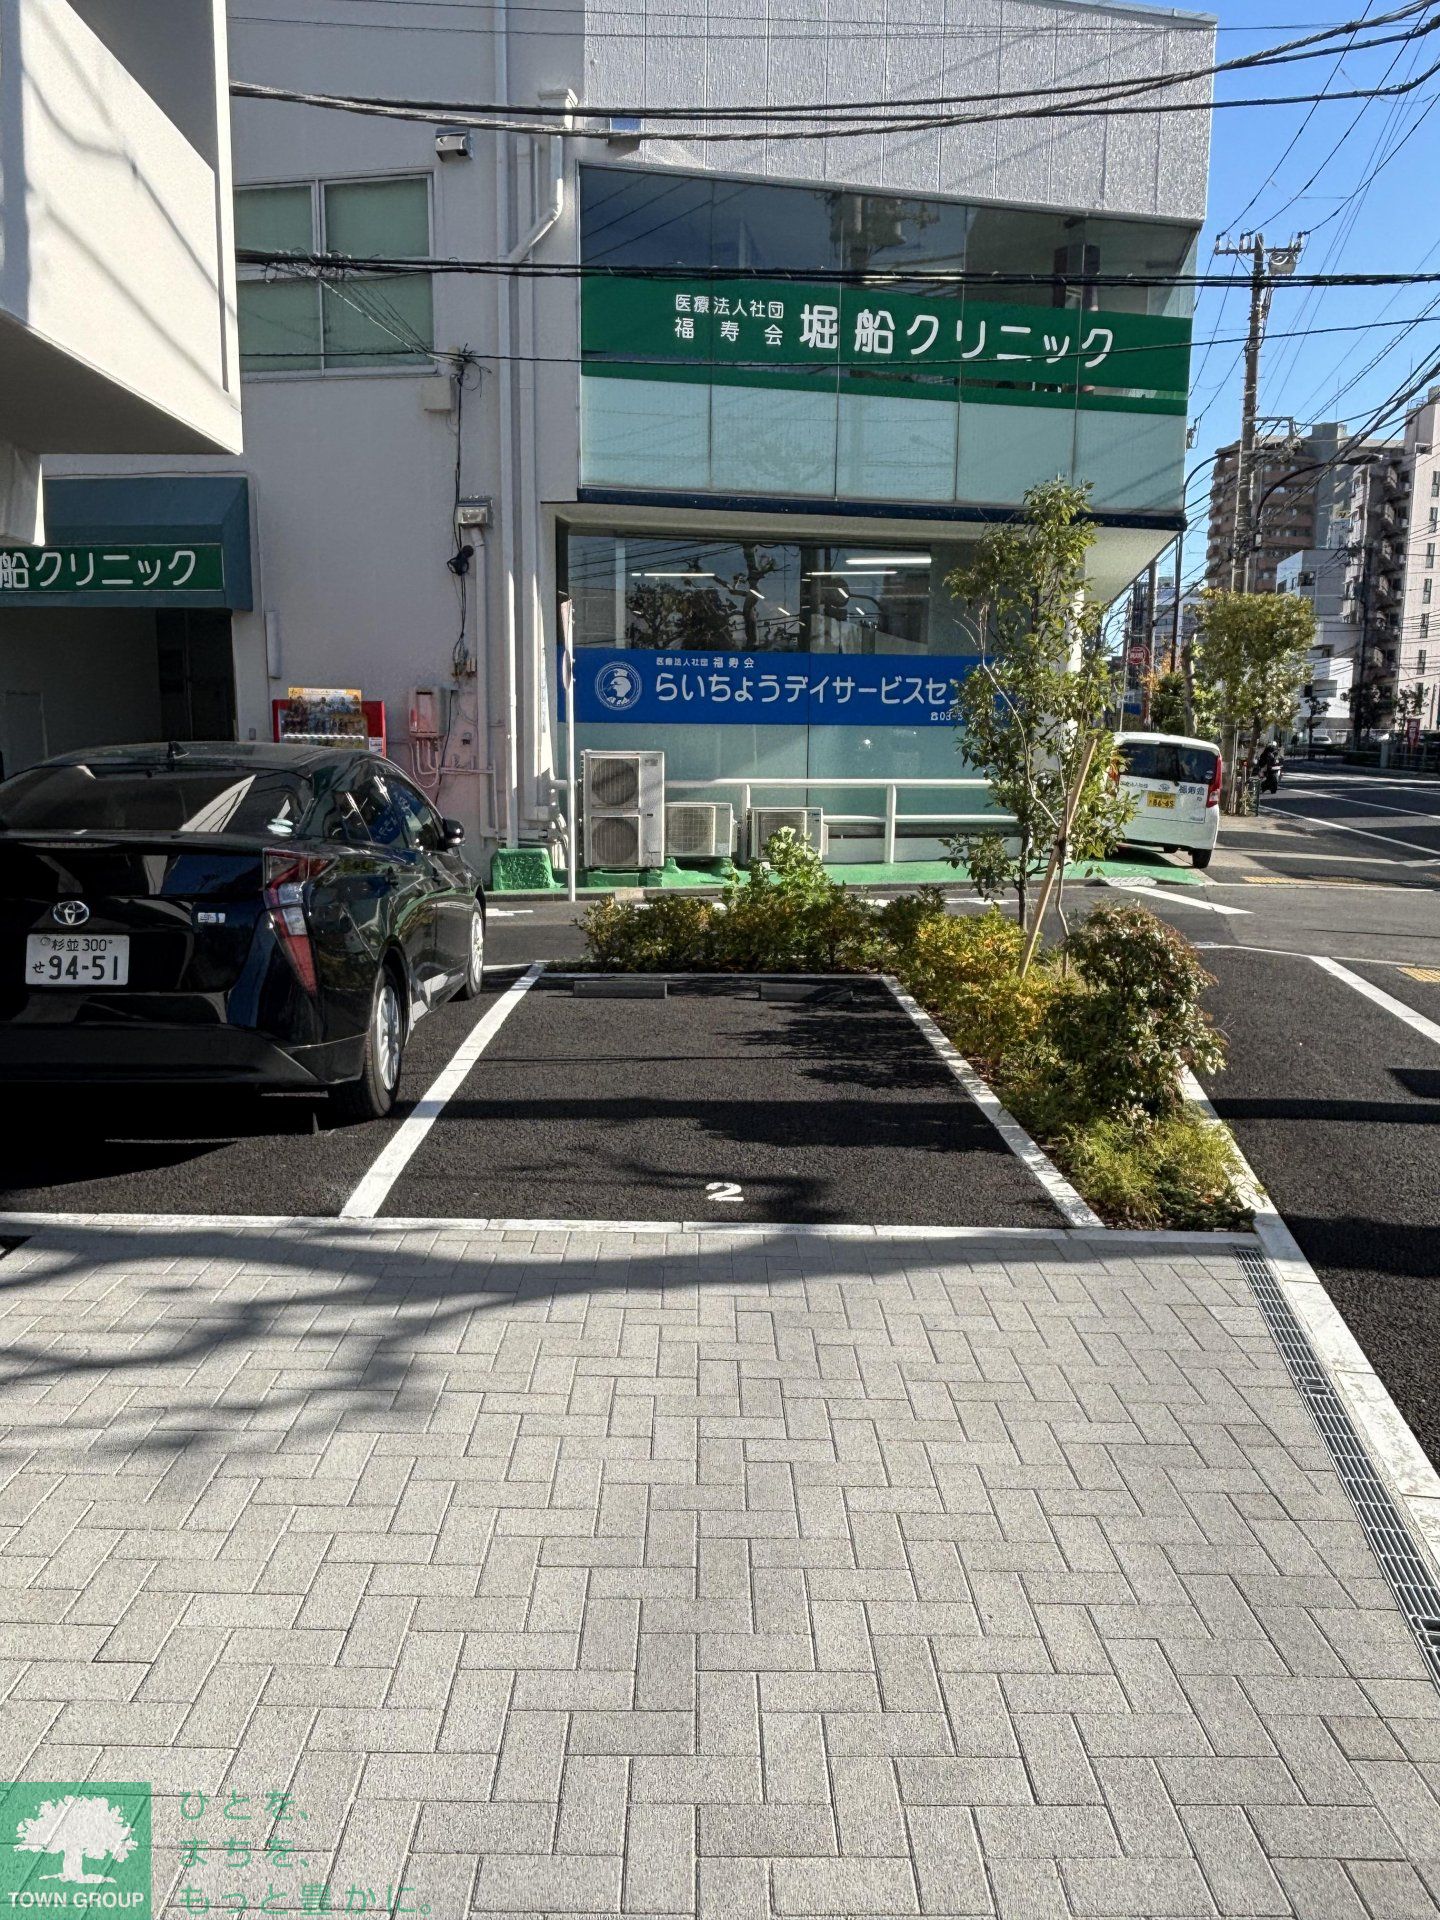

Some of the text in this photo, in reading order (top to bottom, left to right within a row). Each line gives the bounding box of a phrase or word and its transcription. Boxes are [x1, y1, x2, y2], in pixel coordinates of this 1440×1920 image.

[675, 294, 784, 319] 医療法人社団
[674, 317, 783, 346] 福寿会
[800, 304, 1114, 368] 堀船クリニック
[51, 939, 107, 951] 杉並 300
[32, 954, 118, 981] せ 94-51
[705, 1182, 744, 1201] 2
